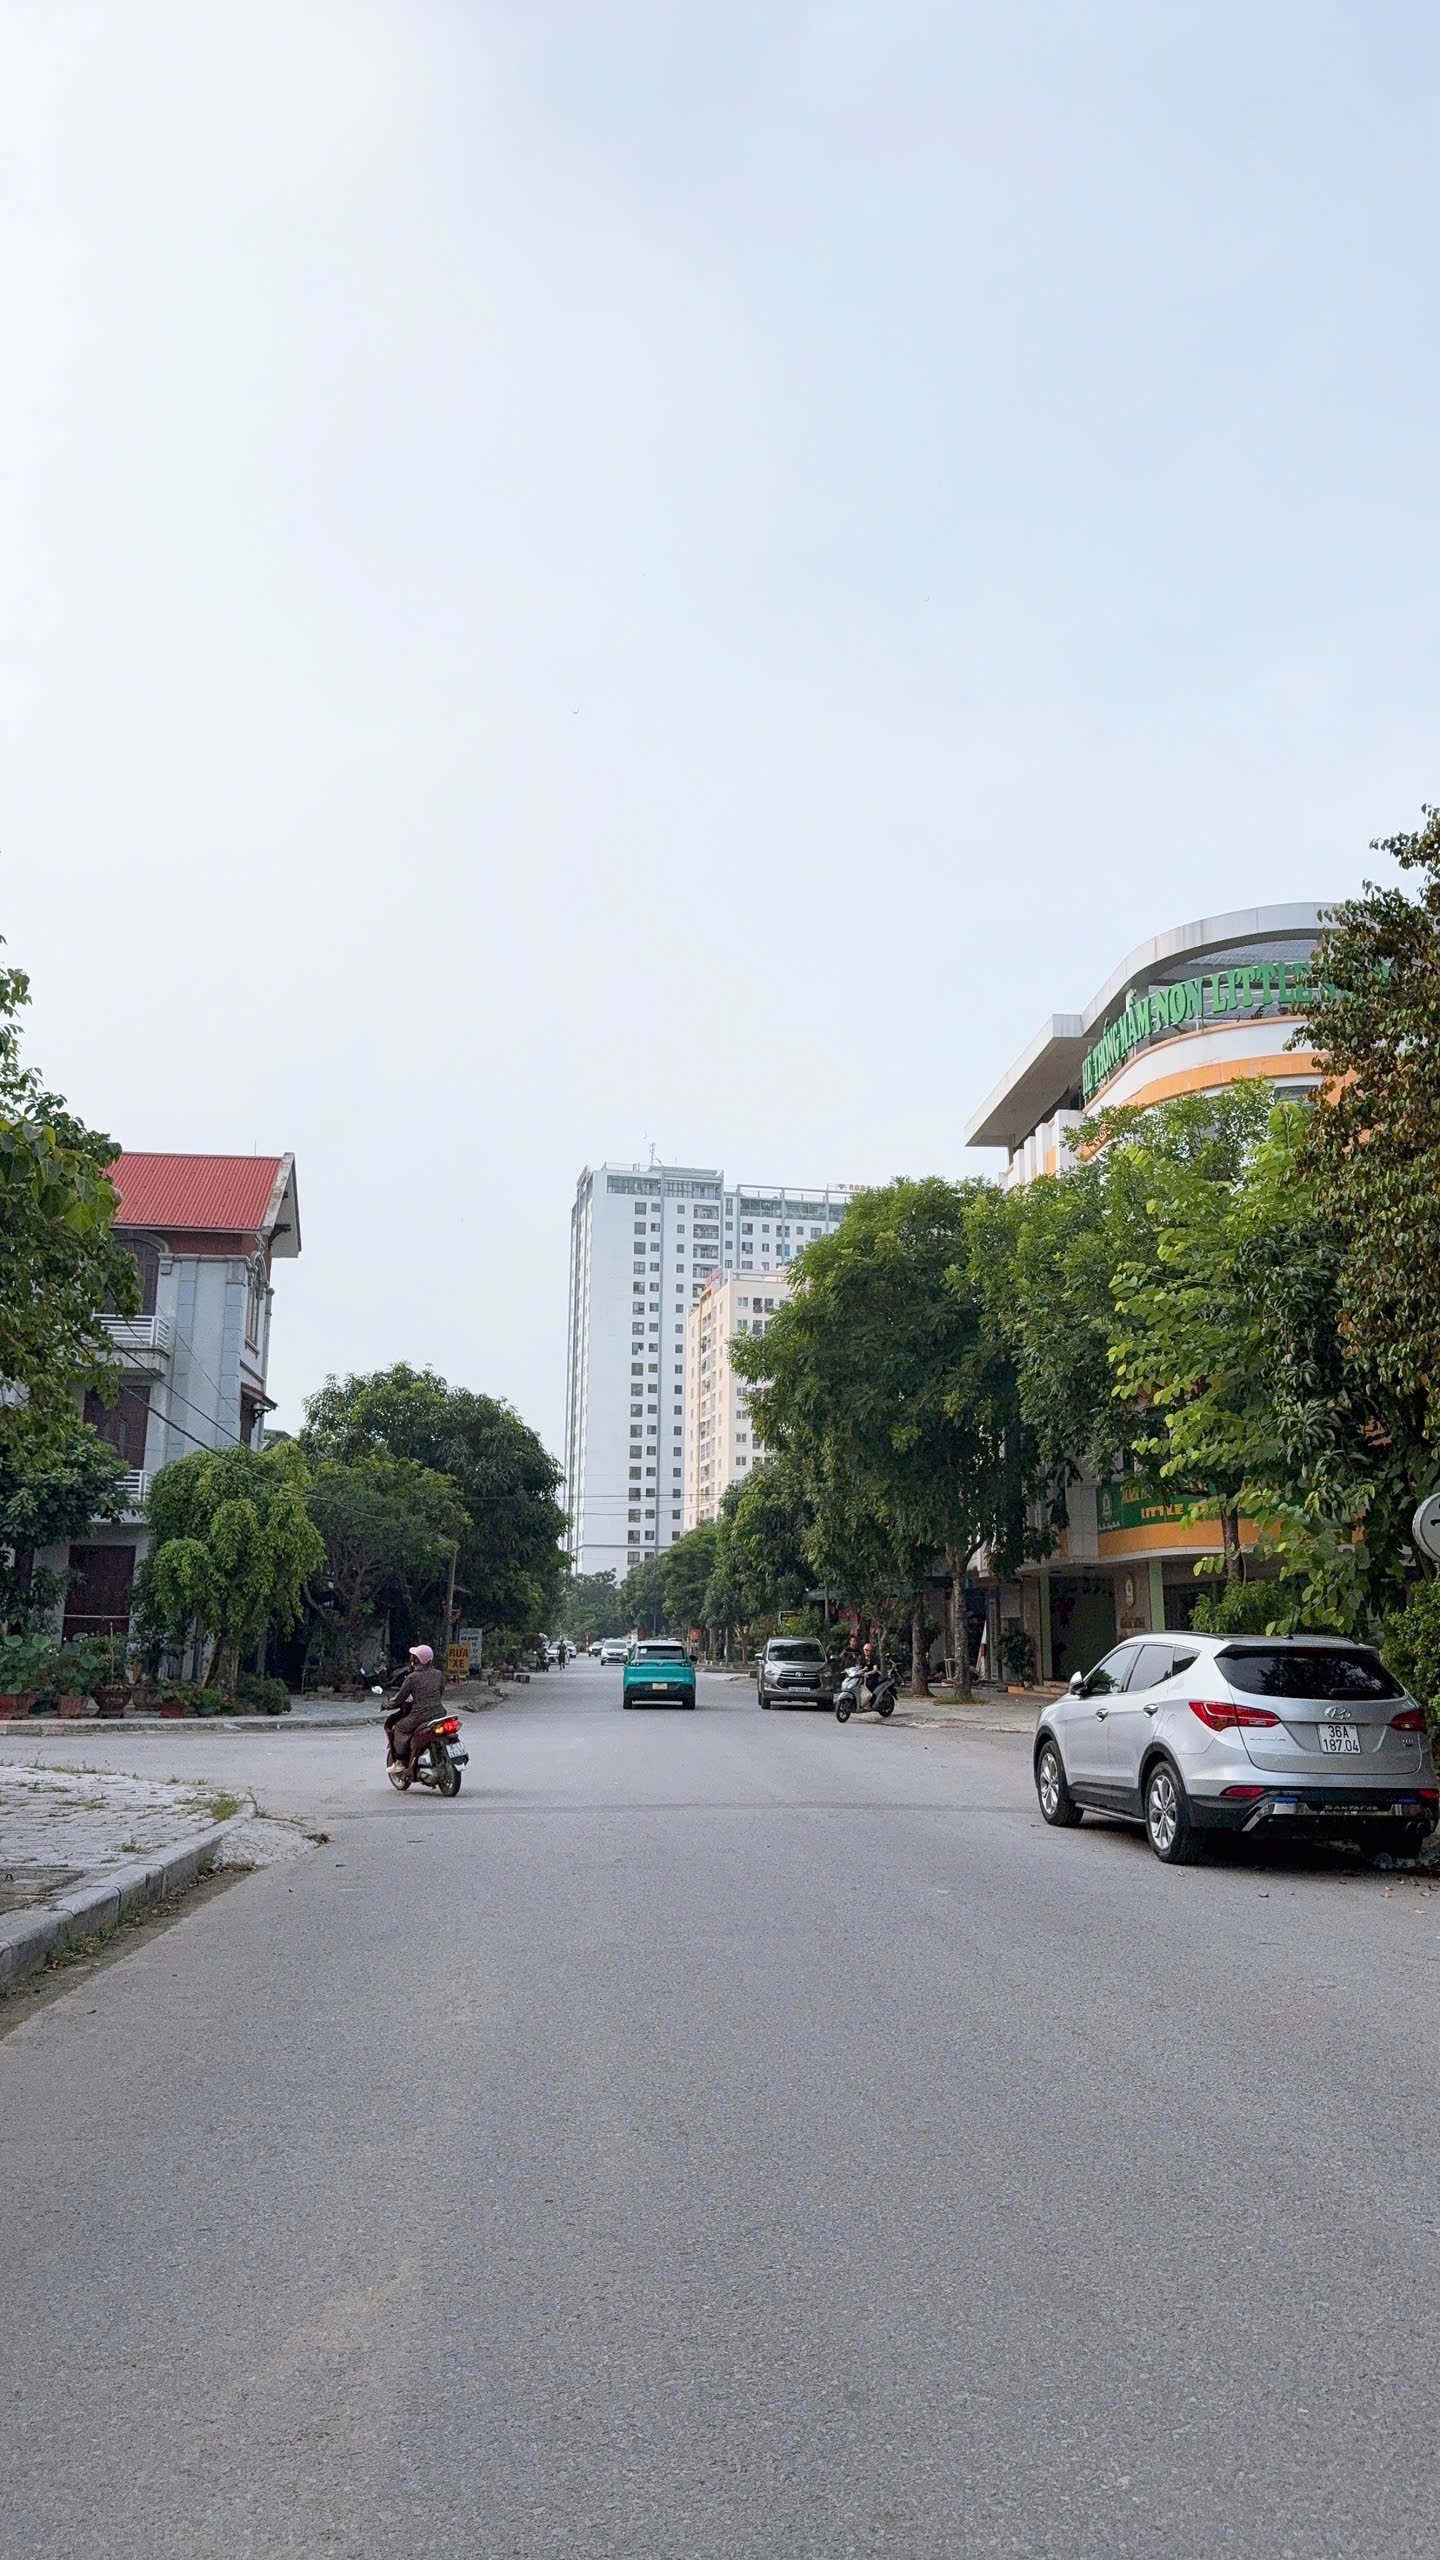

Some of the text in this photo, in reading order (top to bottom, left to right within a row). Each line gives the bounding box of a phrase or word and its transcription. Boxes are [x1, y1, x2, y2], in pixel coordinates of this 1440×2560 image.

[1092, 1017, 1121, 1084] THỐNG
[1119, 987, 1153, 1055] MẦM
[1154, 977, 1204, 1031] NON
[1210, 961, 1317, 1014] LITTLE
[452, 1659, 465, 1668] XE
[1327, 1725, 1350, 1739] 36A
[1323, 1738, 1360, 1752] 187.04
